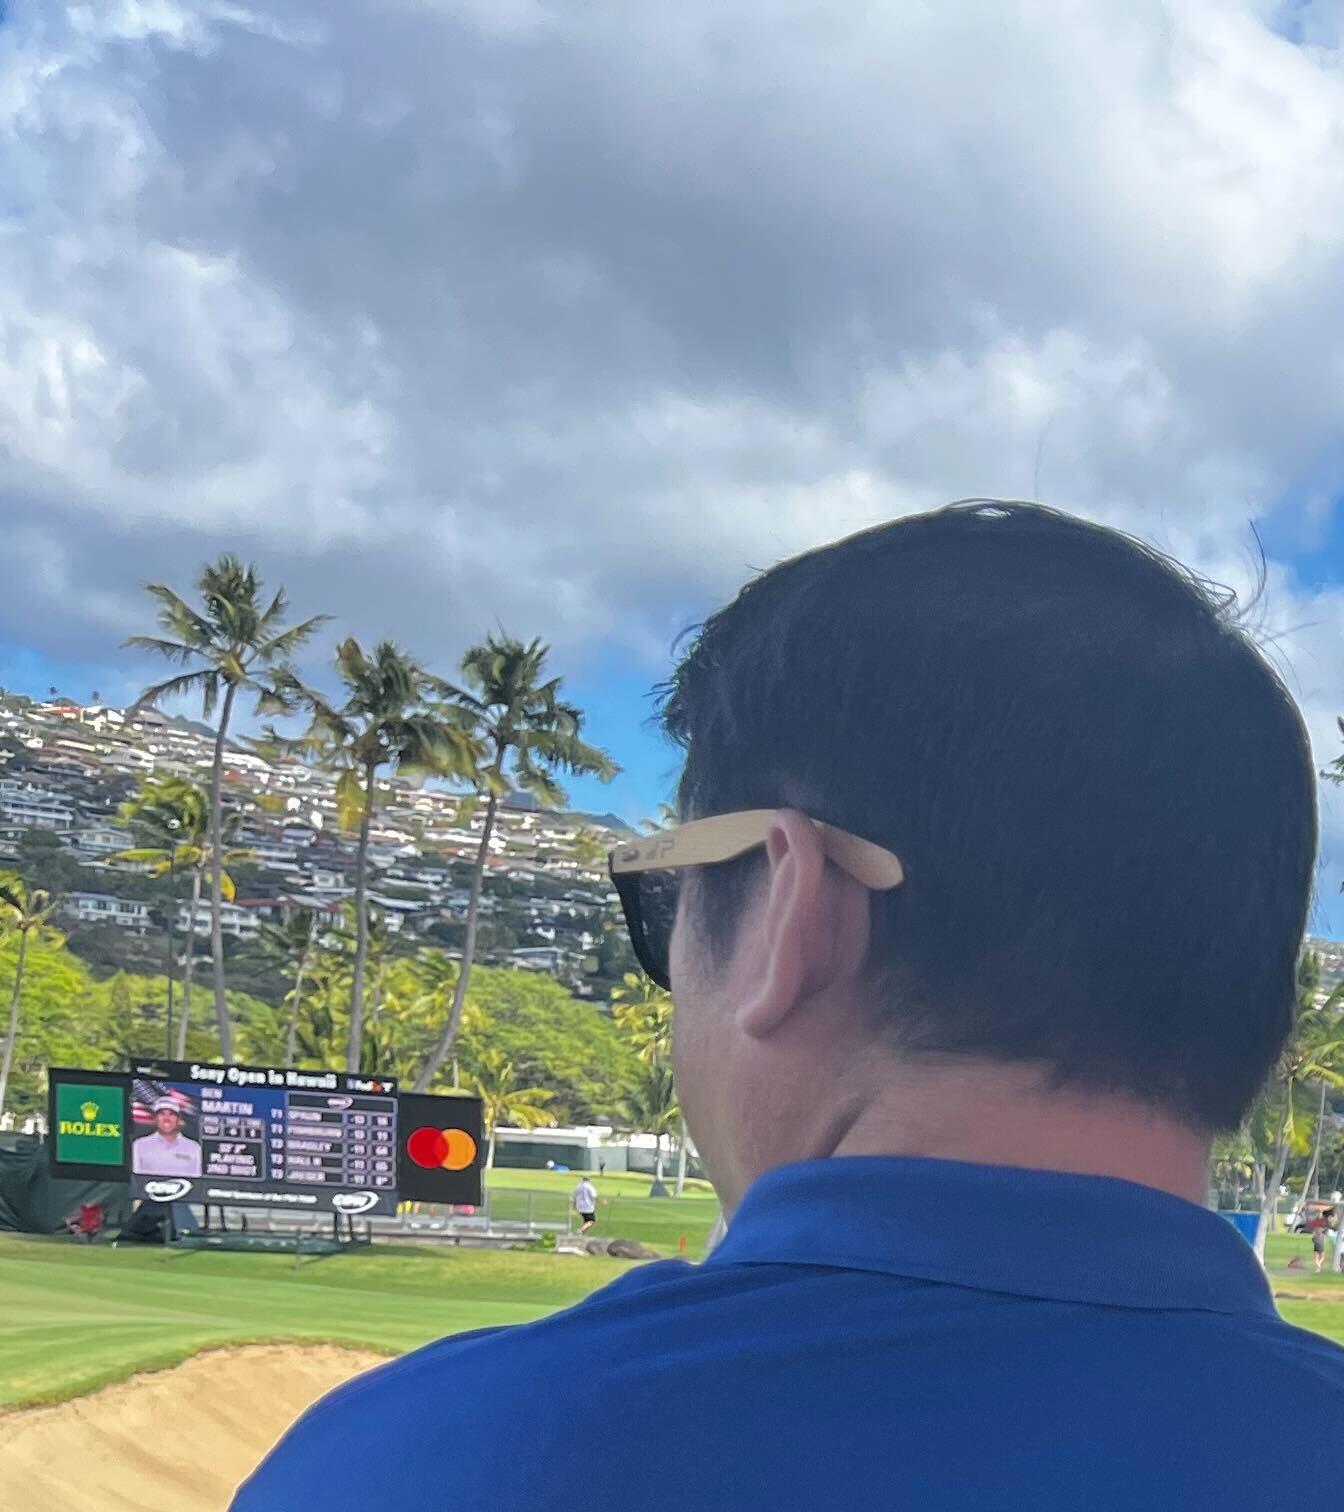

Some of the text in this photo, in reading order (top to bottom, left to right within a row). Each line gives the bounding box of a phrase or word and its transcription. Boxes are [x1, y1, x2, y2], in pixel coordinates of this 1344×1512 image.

[190, 1064, 225, 1084] Sony
[227, 1067, 266, 1086] Open
[286, 1071, 337, 1089] Hawaii
[201, 1100, 253, 1116] MARTIN
[59, 1121, 121, 1138] ROLEX
